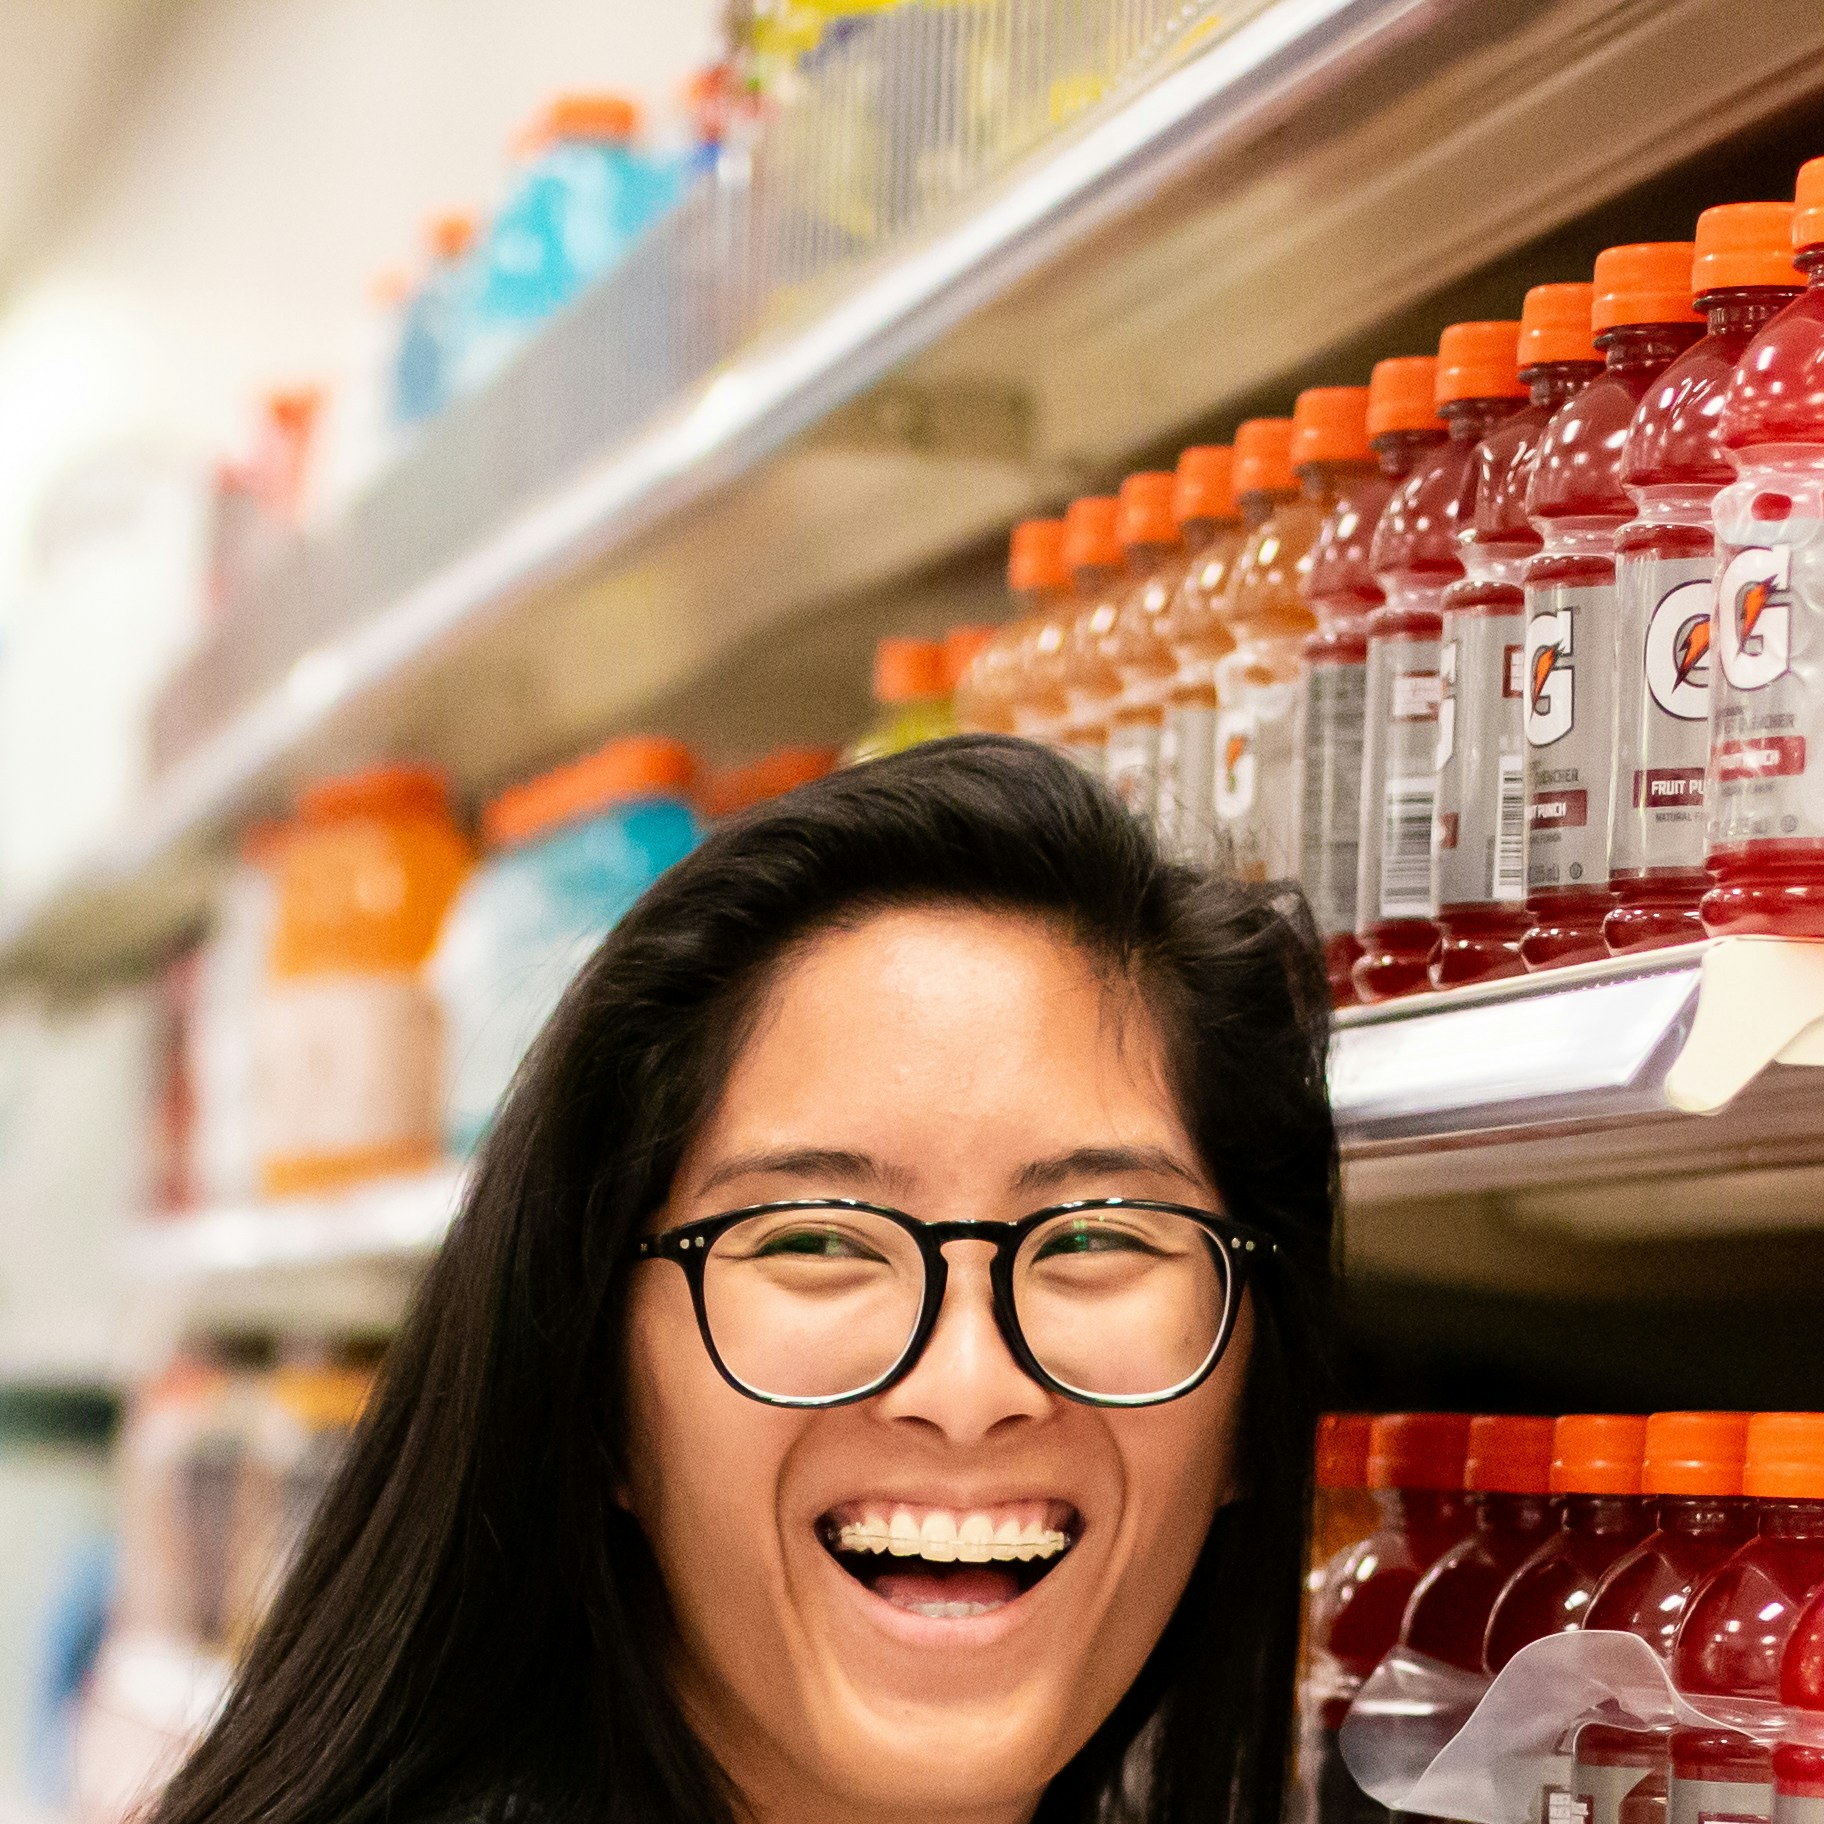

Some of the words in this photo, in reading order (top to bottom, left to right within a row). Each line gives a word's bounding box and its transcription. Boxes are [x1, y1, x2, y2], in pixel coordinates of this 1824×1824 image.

[1526, 608, 1575, 747] G
[1719, 545, 1793, 691] G
[1651, 780, 1685, 796] FRUIT
